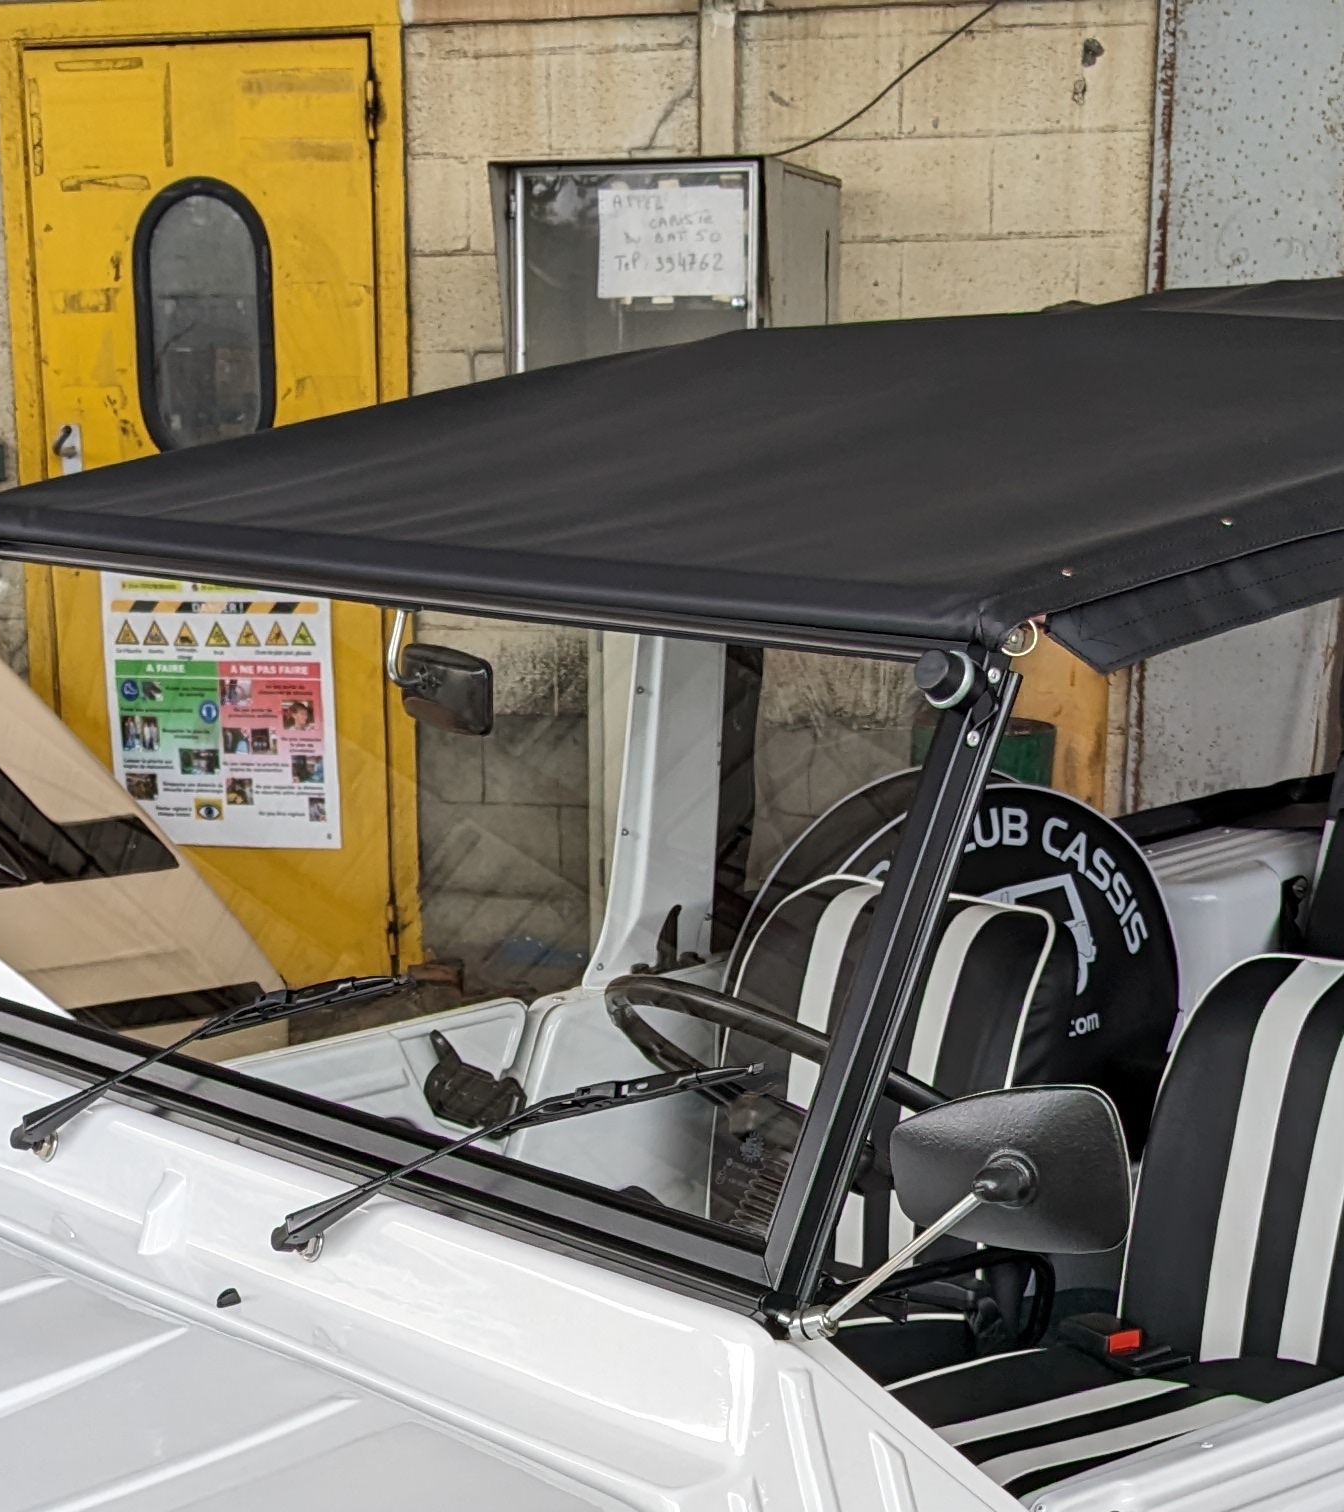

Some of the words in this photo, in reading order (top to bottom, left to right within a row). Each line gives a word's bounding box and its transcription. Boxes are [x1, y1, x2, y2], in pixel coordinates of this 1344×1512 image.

[157, 664, 185, 673] FAIRE
[239, 665, 254, 674] NE
[256, 665, 277, 675] PAS
[278, 666, 309, 675] FAIRE
[1041, 817, 1150, 956] CASSIS
